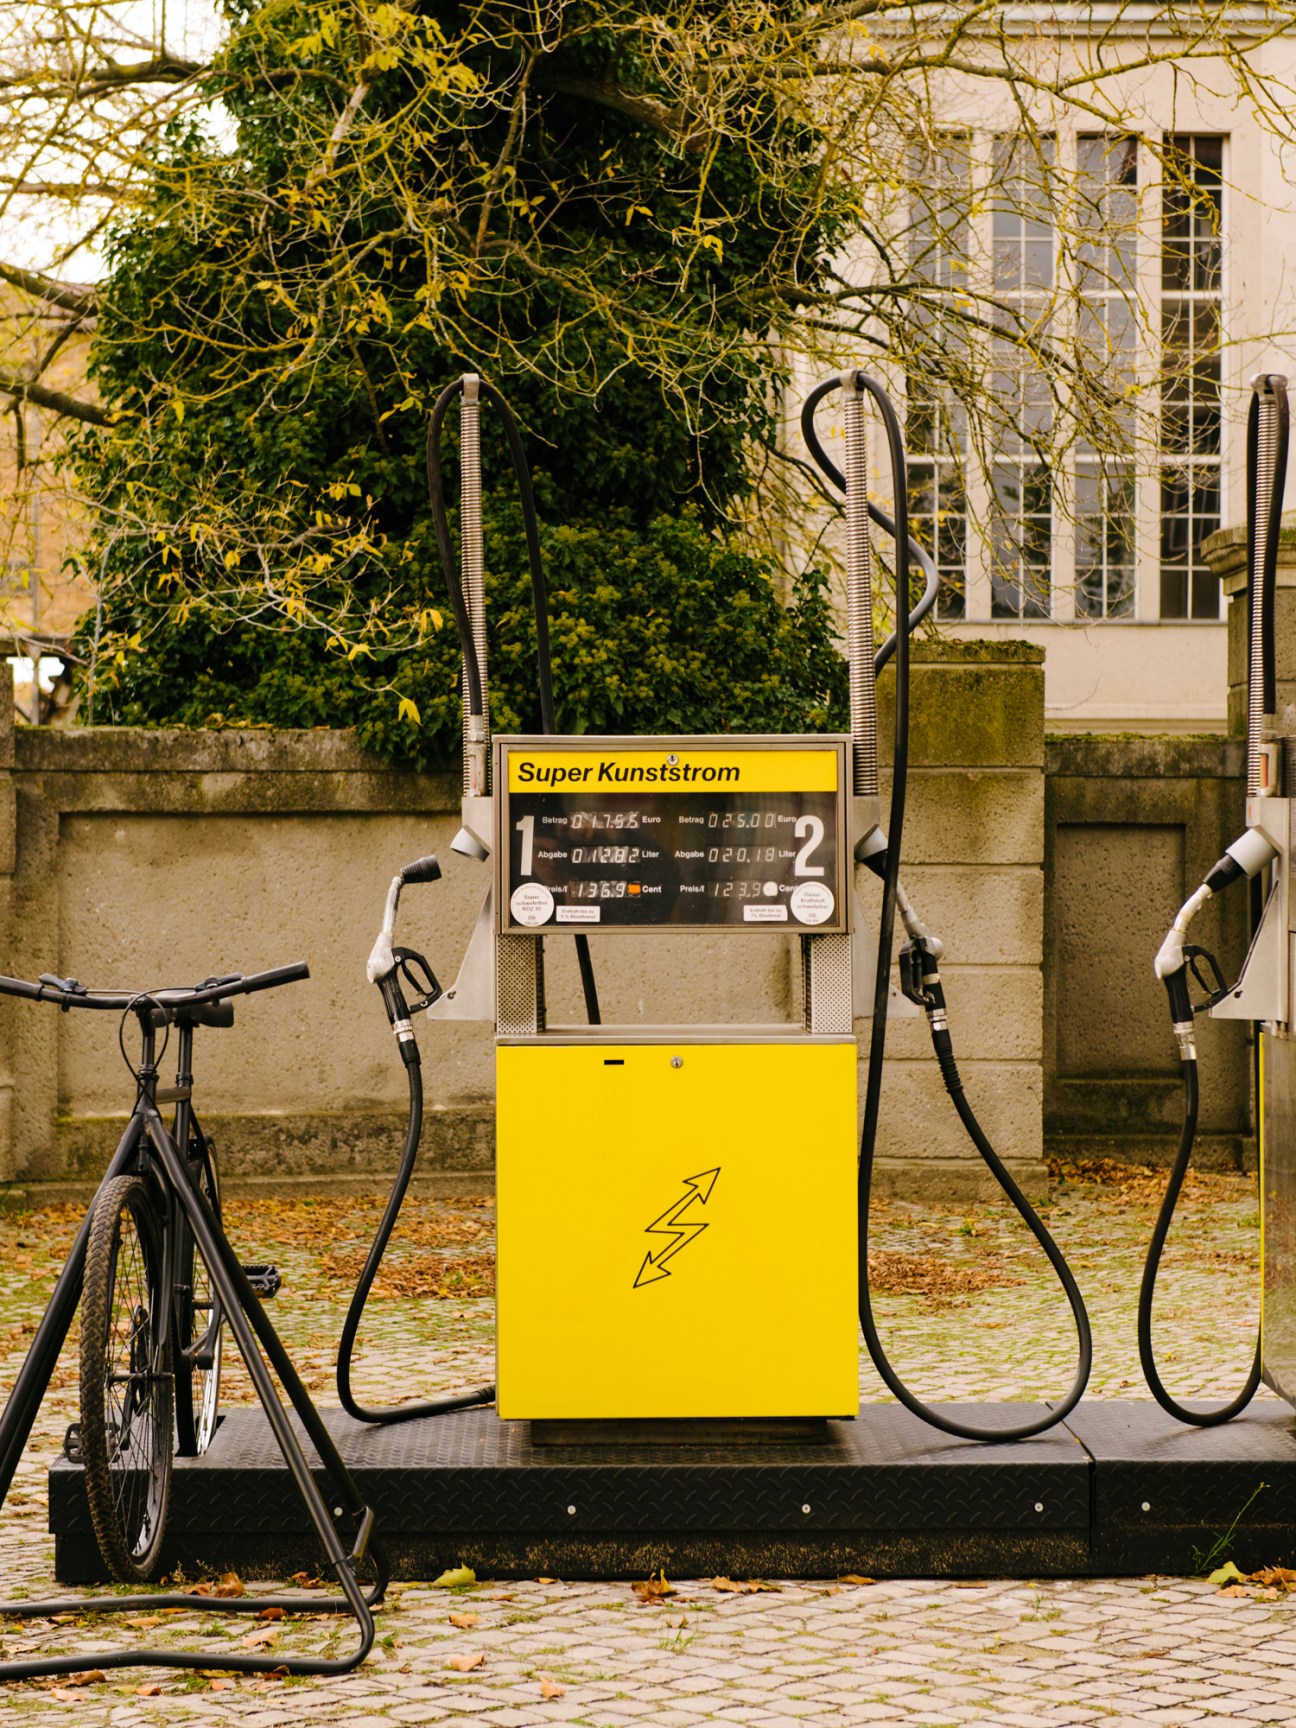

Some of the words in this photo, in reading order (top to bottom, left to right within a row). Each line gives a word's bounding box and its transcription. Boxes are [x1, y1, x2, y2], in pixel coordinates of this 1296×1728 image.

[517, 762, 593, 787] Super
[598, 762, 740, 782] Kunststrom
[542, 816, 568, 825] Betrag
[678, 816, 704, 824] Betrag
[777, 815, 797, 823] Euro
[516, 815, 534, 876] 1
[795, 815, 825, 876] 2
[538, 850, 568, 859] Abgabe
[642, 850, 659, 858] Liter
[675, 850, 704, 859] Abgabe
[778, 850, 796, 858] Liter
[642, 885, 662, 893] Cent
